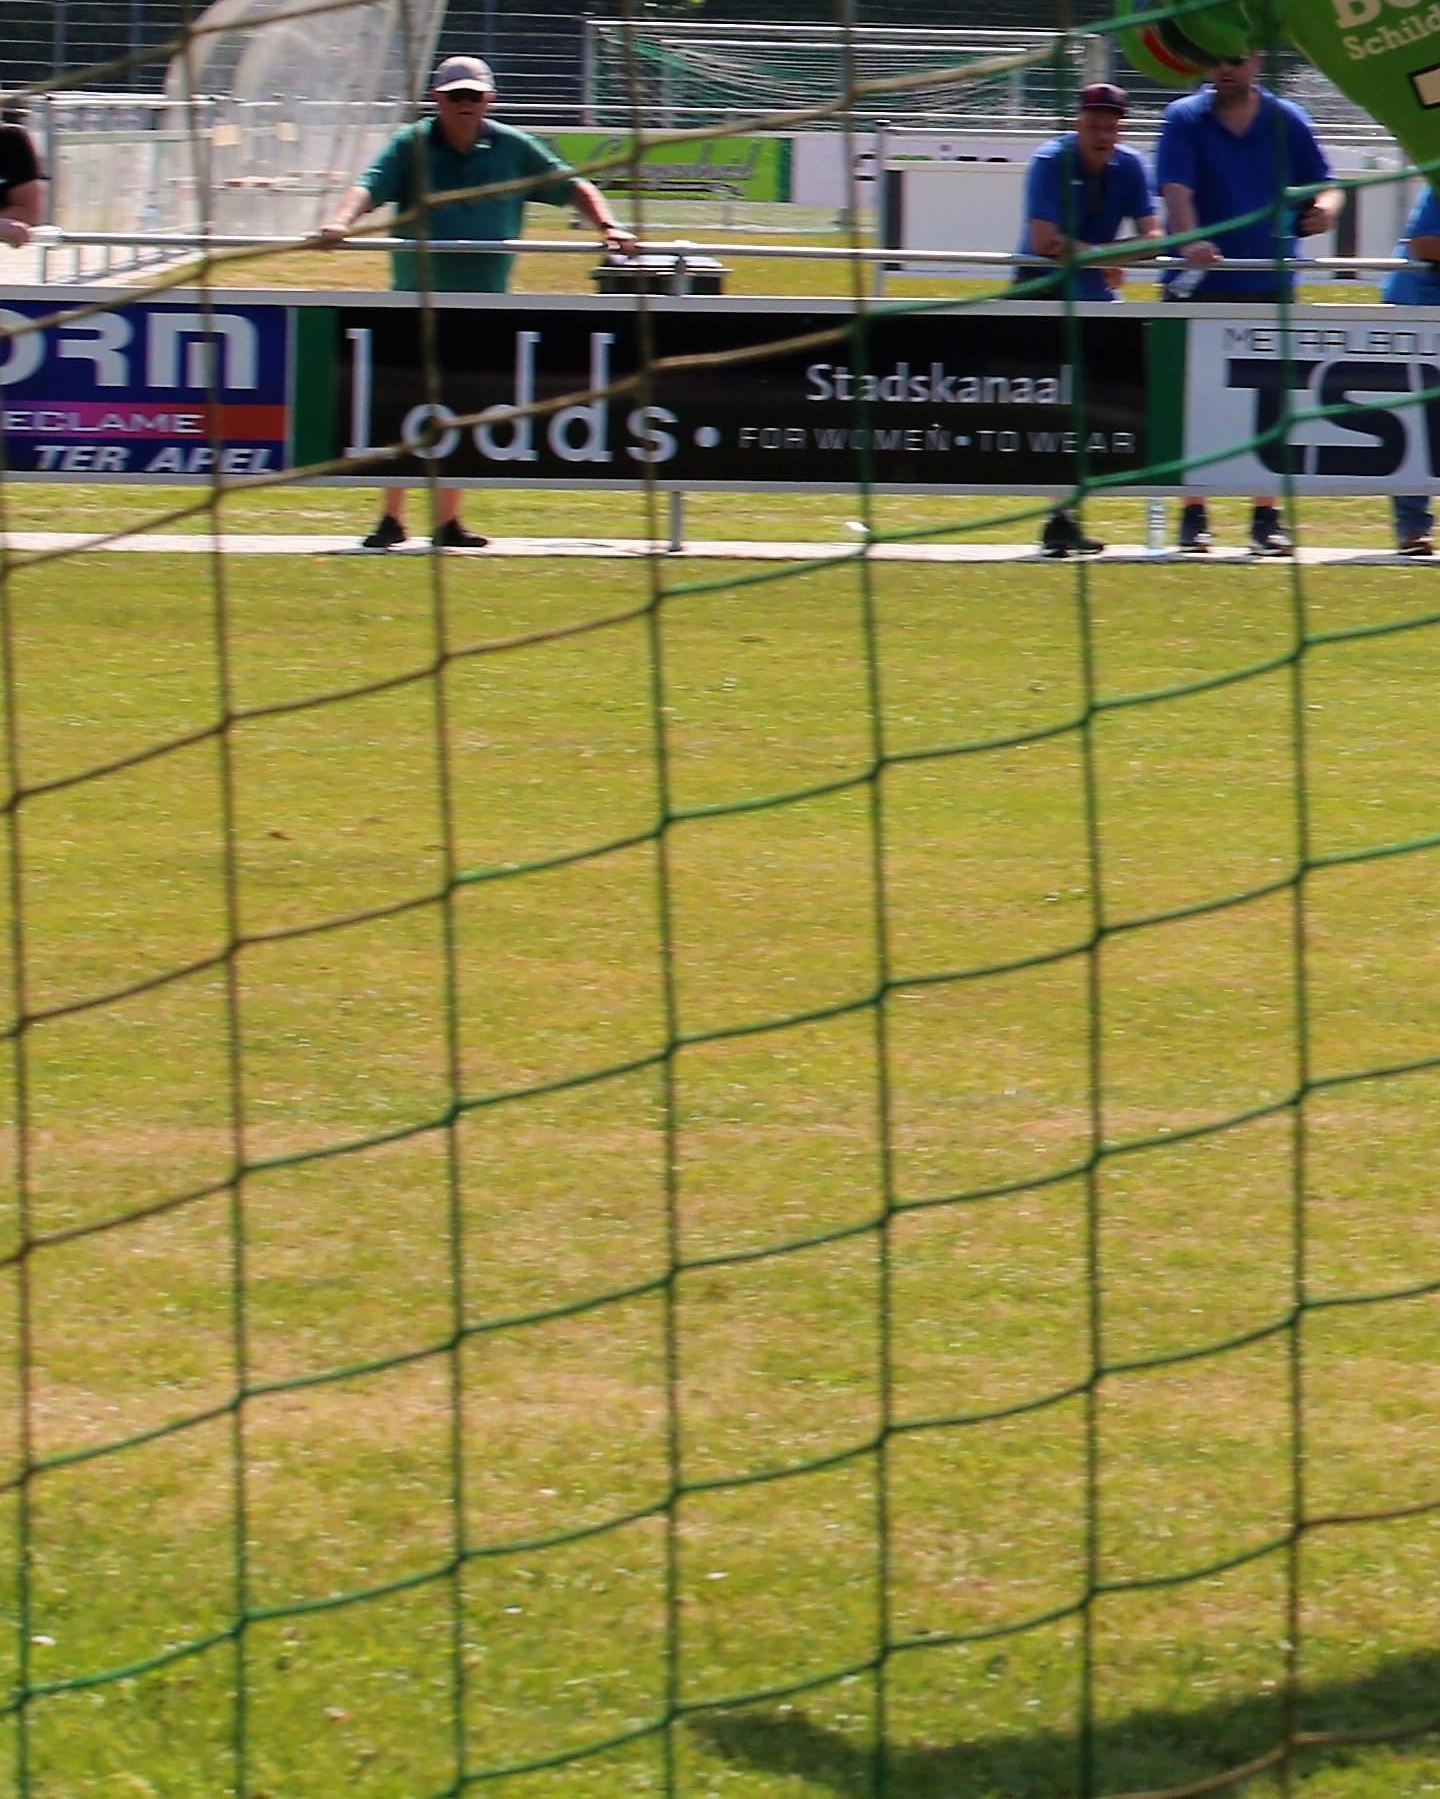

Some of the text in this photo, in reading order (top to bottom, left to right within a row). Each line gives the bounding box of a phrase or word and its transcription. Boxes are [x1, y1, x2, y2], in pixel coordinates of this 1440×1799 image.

[805, 362, 1074, 404] Stadskanaal
[738, 427, 806, 450] FOR
[976, 430, 1021, 452] TO
[1028, 431, 1137, 455] WEAR
[34, 445, 132, 472] TER
[143, 447, 277, 475] APEL
